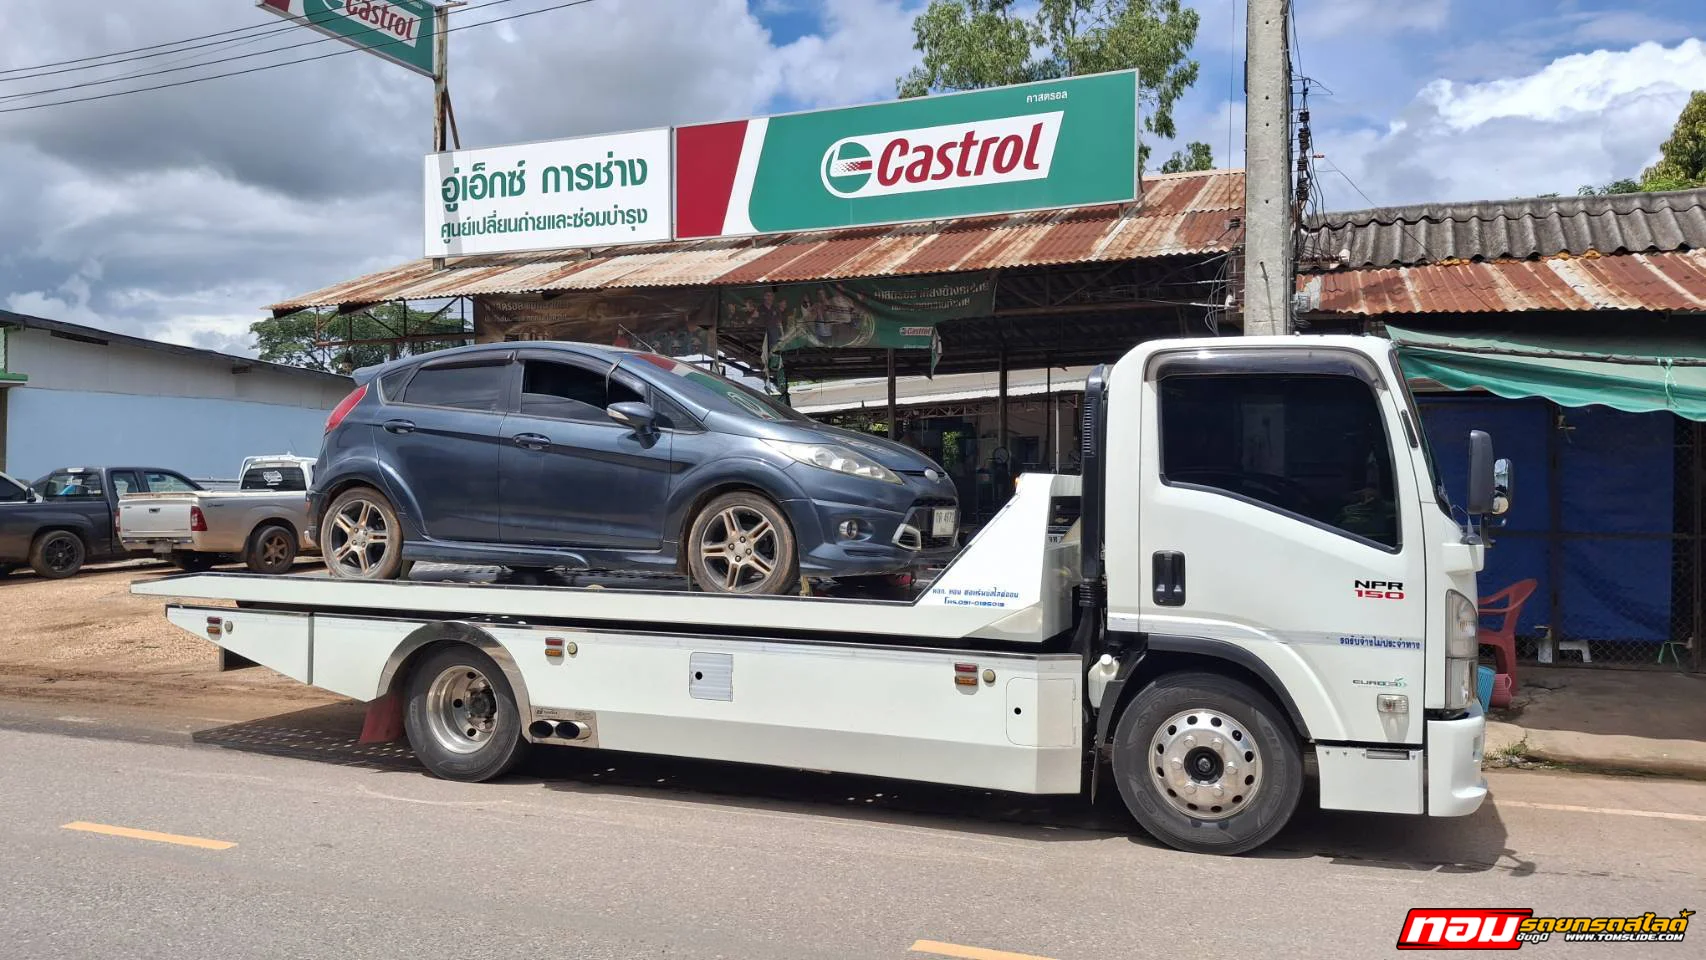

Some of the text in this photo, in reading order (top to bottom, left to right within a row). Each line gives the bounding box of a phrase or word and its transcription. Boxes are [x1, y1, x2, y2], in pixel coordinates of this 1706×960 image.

[345, 0, 414, 40] Castrol
[1026, 90, 1068, 104] คาสตรอล
[877, 122, 1044, 187] Castrol
[441, 151, 648, 212] อู่เอ็กซ์ การช่าง
[441, 204, 648, 244] ศูนย์เปลี่ยนถ่ายและซ่อมบำรุง
[1354, 580, 1404, 590] NPR
[1354, 589, 1405, 600] 150
